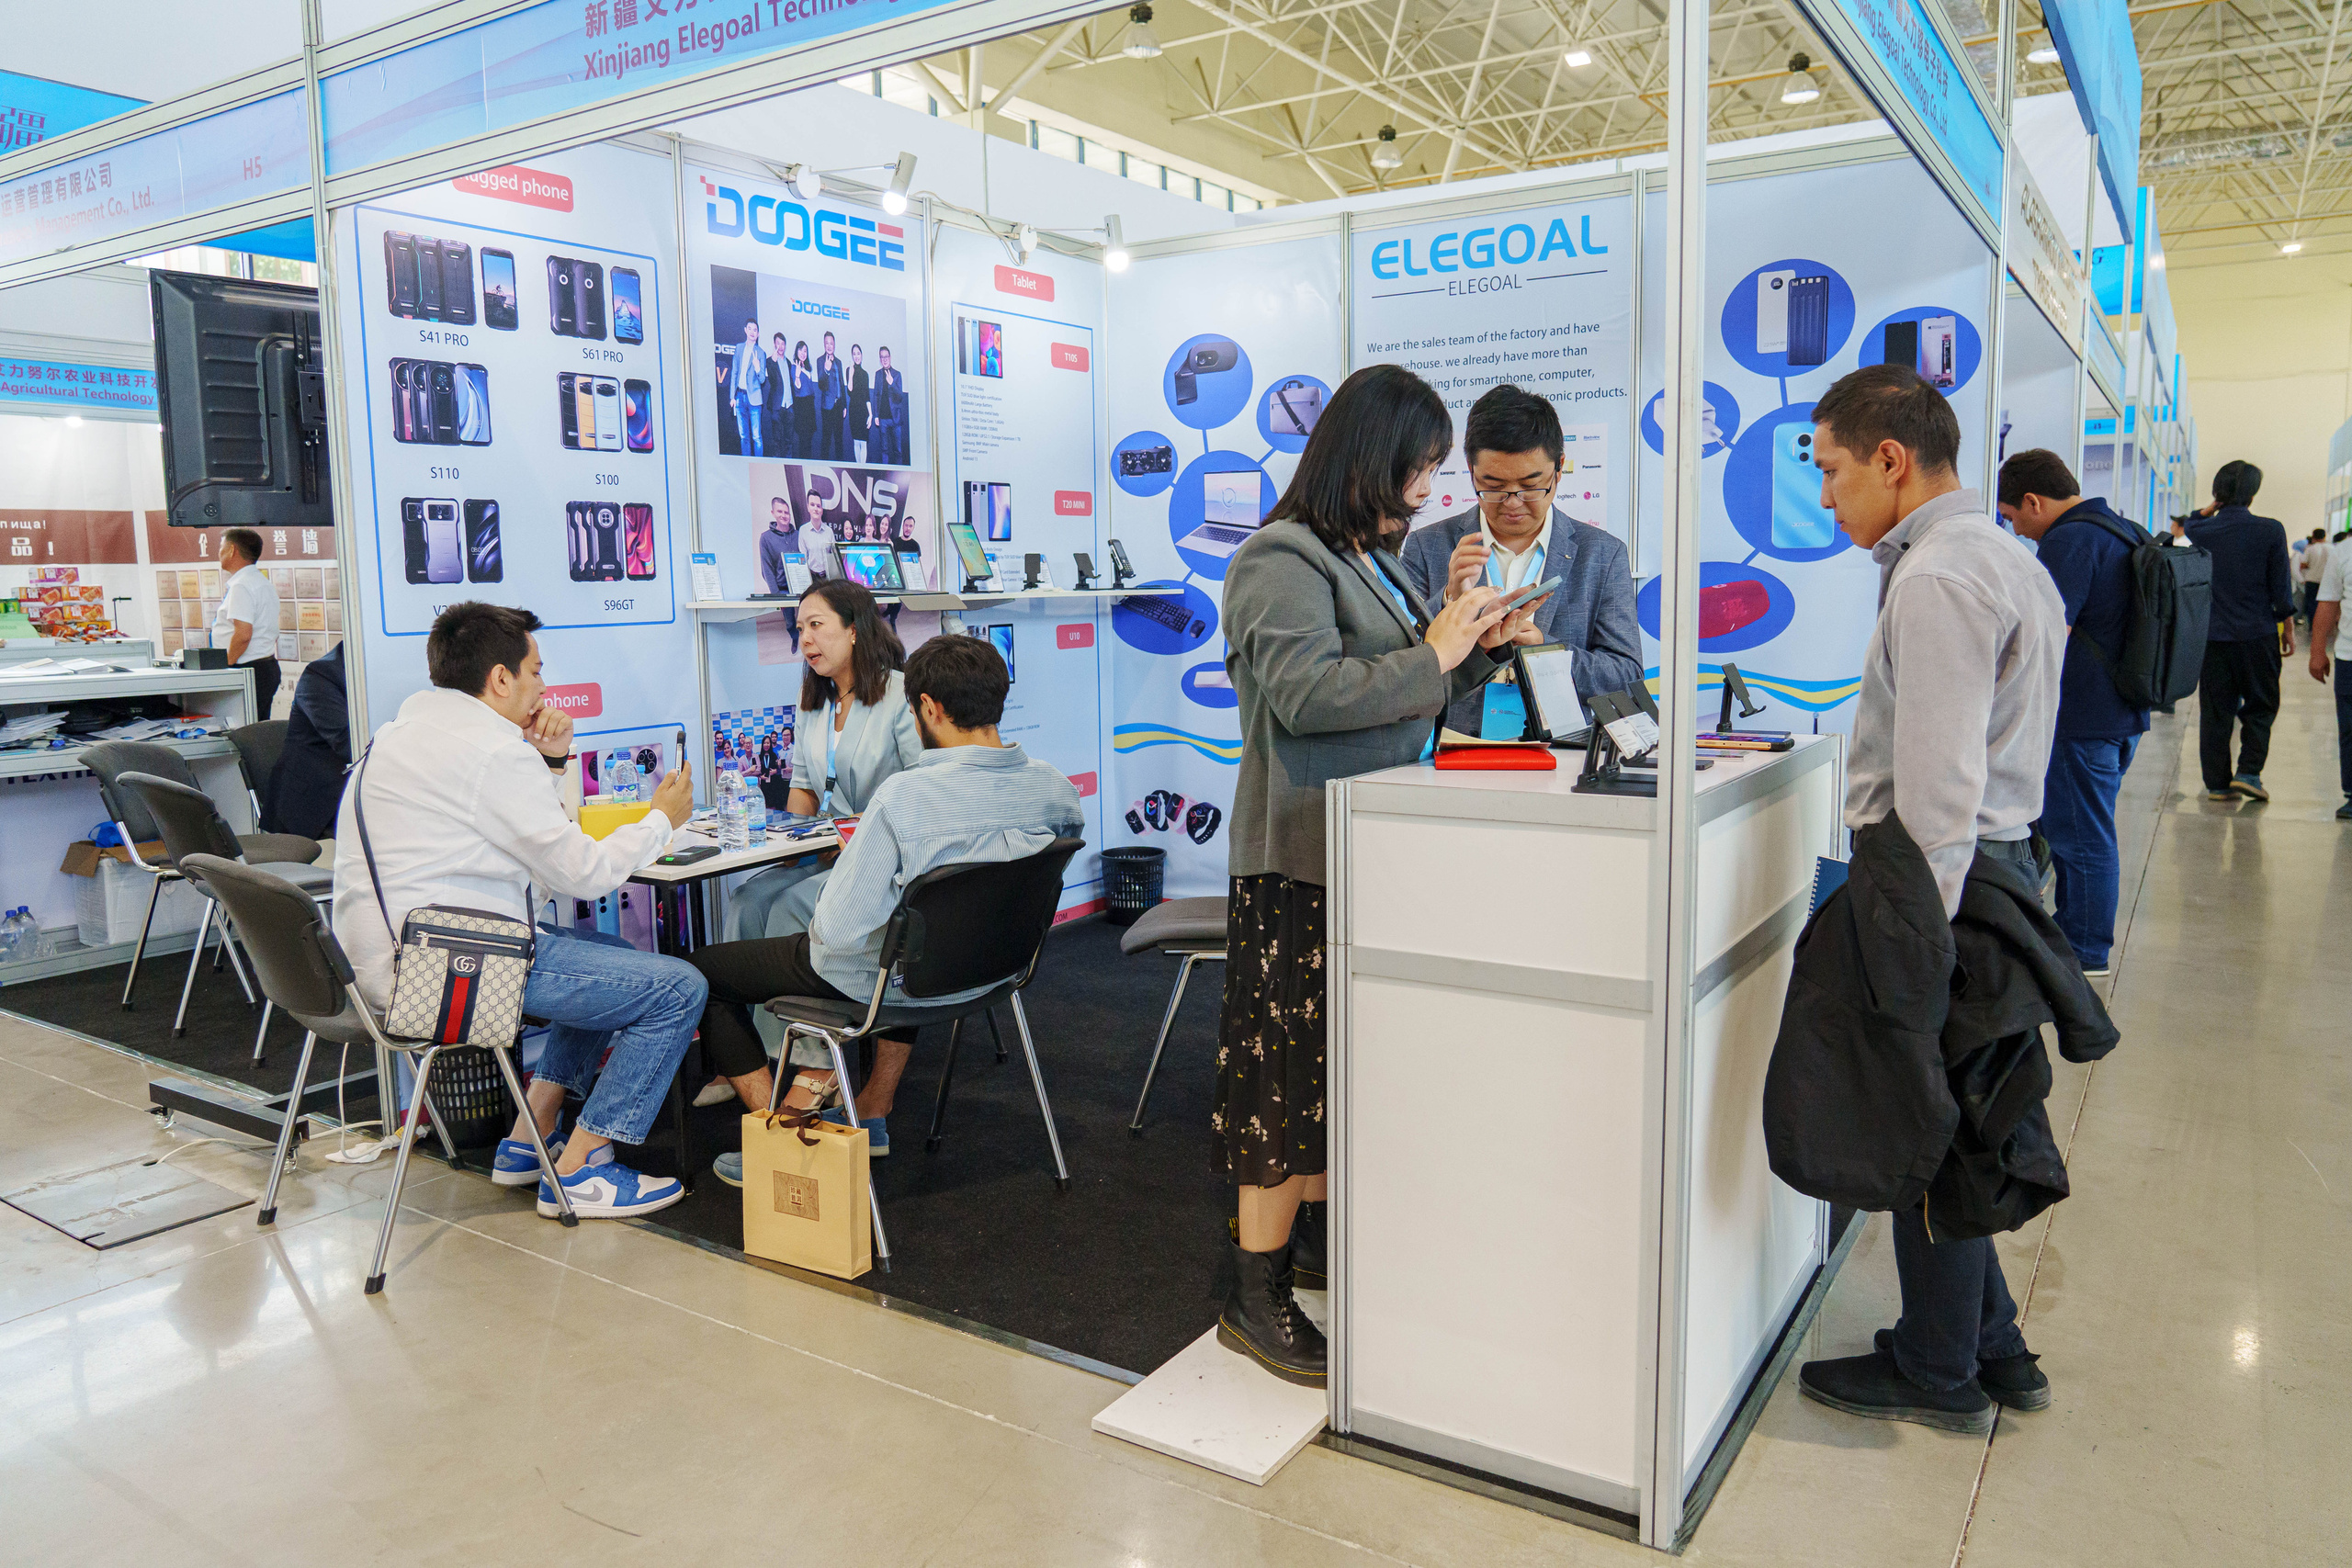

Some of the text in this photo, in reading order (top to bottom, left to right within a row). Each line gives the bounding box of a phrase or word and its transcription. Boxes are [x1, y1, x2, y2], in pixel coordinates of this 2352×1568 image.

[583, 41, 670, 81] Xinjiang
[678, 6, 761, 54] Elegoal
[1877, 11, 1900, 64] Elegoal
[1901, 44, 1929, 117] Technology
[243, 156, 263, 181] H5
[1, 162, 112, 218] 运营管理有限公司
[523, 178, 569, 201] phone
[35, 204, 105, 240] Management
[131, 186, 155, 211] Ltd.
[700, 175, 905, 272] DOOGEE
[1371, 214, 1608, 280] ELEGOAL
[1012, 274, 1037, 291] Tablet
[1448, 274, 1522, 296] ELEGOAL
[790, 297, 850, 321] DOOGEE
[419, 330, 469, 347] S41 PRO
[1367, 322, 1600, 354] We are the sales team of the factory and have
[582, 347, 624, 363] S61 PRO
[1064, 352, 1078, 363] T10S
[1401, 345, 1587, 371] rehouse. we already have more than
[1429, 367, 1595, 391] king for smartphone, computer,
[1, 381, 154, 405] Agricultural Technology
[1443, 399, 1463, 410] duct
[1542, 390, 1572, 401] tronic
[1575, 387, 1627, 400] products.
[430, 467, 459, 480] S110
[594, 473, 619, 486] S100
[801, 465, 899, 517] DNS
[1062, 500, 1085, 509] T20 MINI
[0, 520, 46, 530] пища!
[604, 599, 635, 612] S96GT
[1069, 632, 1080, 641] U10
[544, 693, 589, 709] phone
